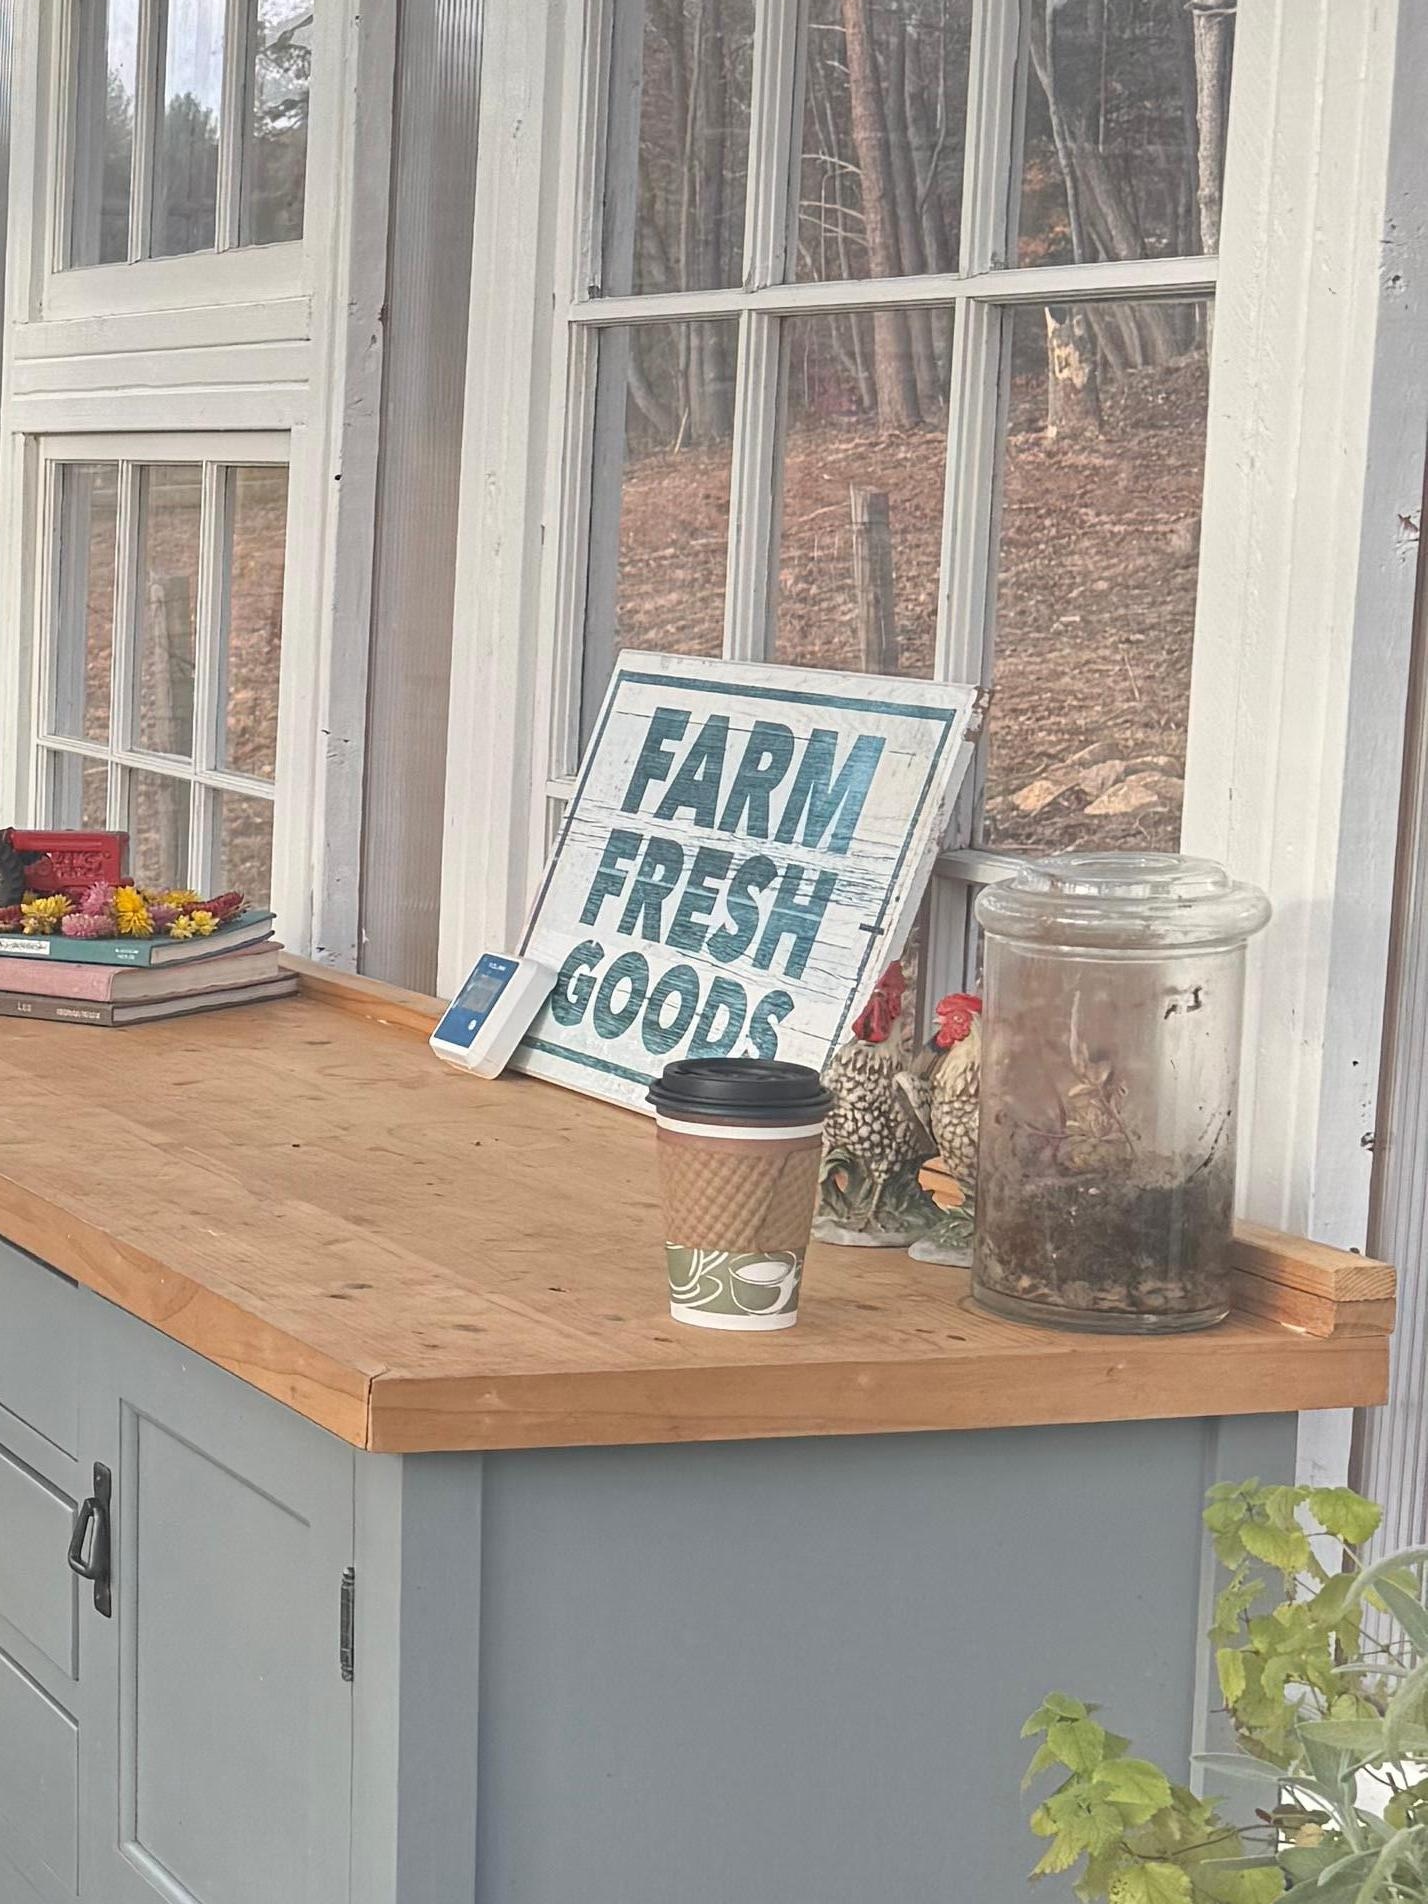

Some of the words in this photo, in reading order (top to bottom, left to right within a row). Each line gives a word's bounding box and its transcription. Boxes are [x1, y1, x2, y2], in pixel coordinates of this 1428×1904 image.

[620, 707, 886, 855] FARM
[578, 829, 838, 980] FRESH
[550, 940, 795, 1062] GOODS
